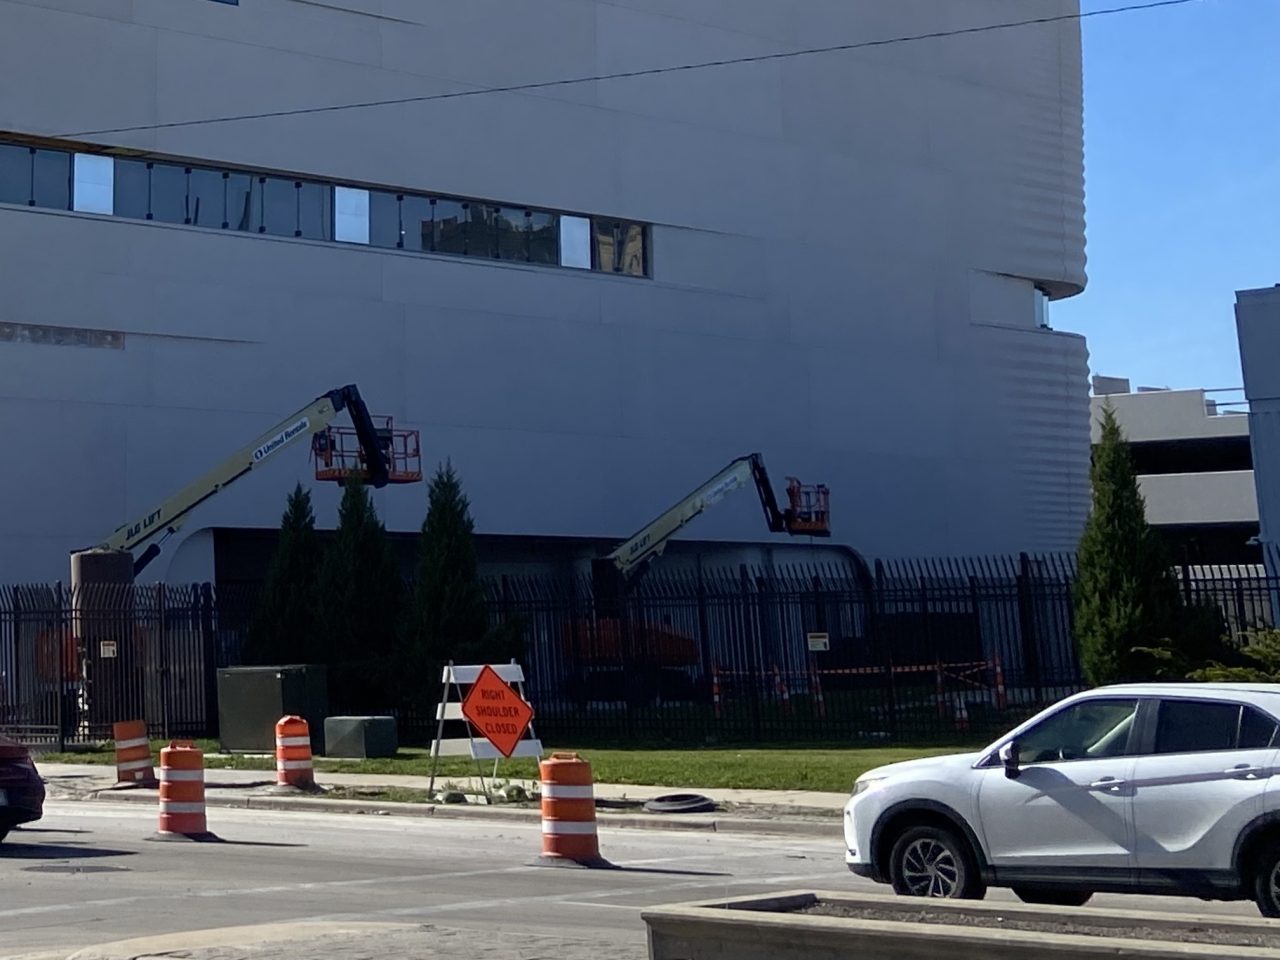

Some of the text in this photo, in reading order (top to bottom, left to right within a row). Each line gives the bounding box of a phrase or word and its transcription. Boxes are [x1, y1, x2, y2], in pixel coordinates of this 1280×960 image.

[263, 420, 308, 455] United Rentals
[126, 508, 161, 540] JLG LIFT
[481, 689, 505, 700] RIGHT
[475, 706, 520, 717] SHOULDER
[485, 722, 518, 735] CLOSED
